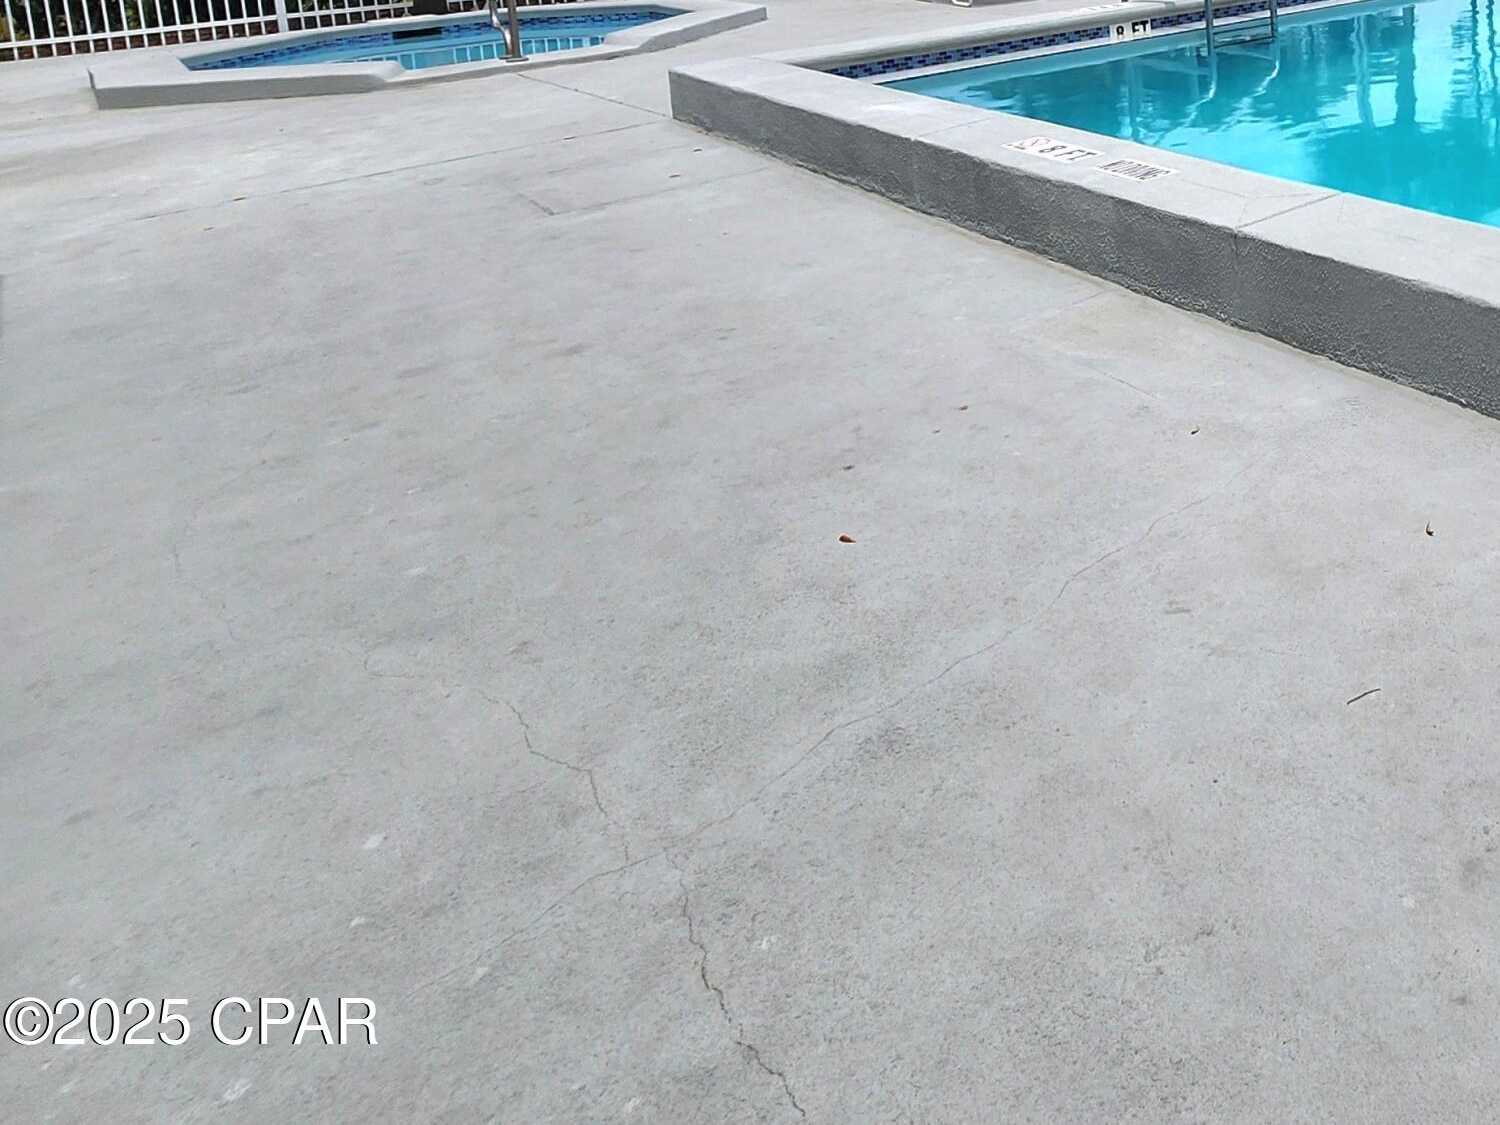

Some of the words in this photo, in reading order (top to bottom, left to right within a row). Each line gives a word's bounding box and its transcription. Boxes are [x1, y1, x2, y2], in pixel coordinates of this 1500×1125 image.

[1131, 19, 1149, 33] FT
[1038, 144, 1068, 155] 8
[1054, 148, 1097, 162] FT
